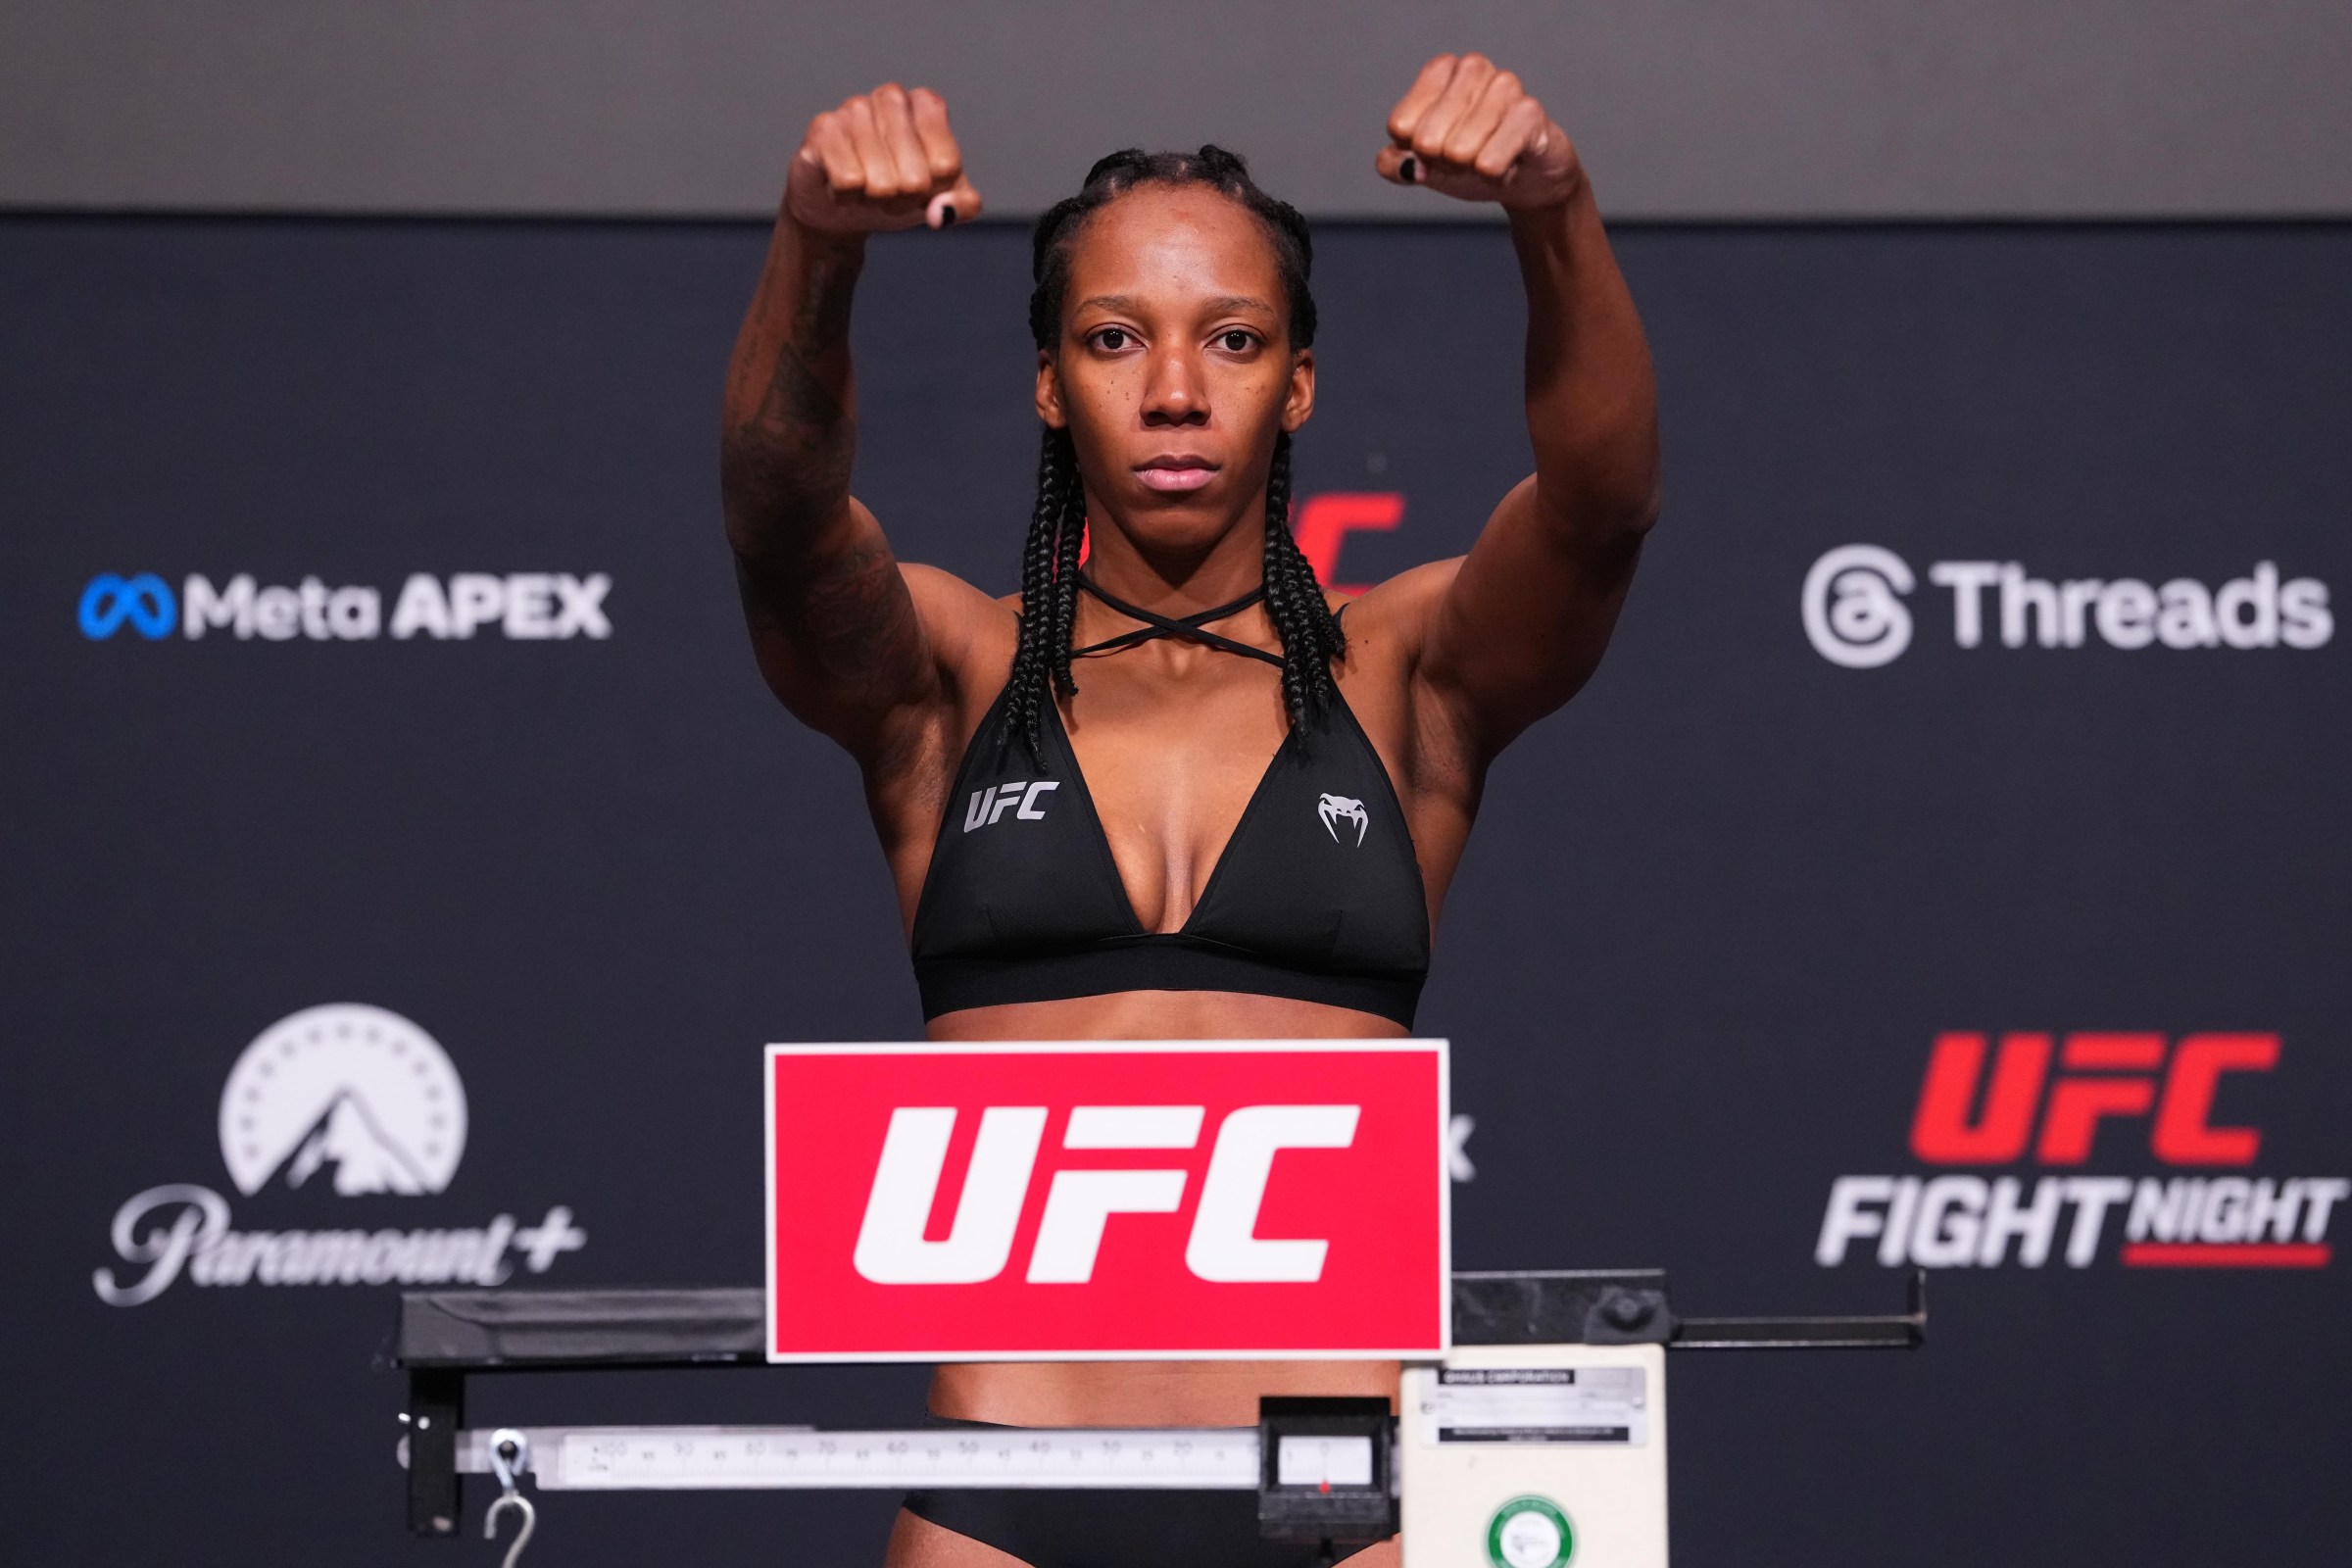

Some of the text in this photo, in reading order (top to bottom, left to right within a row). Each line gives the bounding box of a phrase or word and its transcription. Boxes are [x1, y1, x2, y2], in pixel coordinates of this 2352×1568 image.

[183, 572, 612, 640] Meta APEX
[1929, 561, 2334, 650] Threads
[963, 781, 1060, 833] UFC
[1910, 1032, 2281, 1165] UFC
[853, 1104, 1362, 1285] UFC
[1814, 1176, 2350, 1268] FIGHT NIGHT
